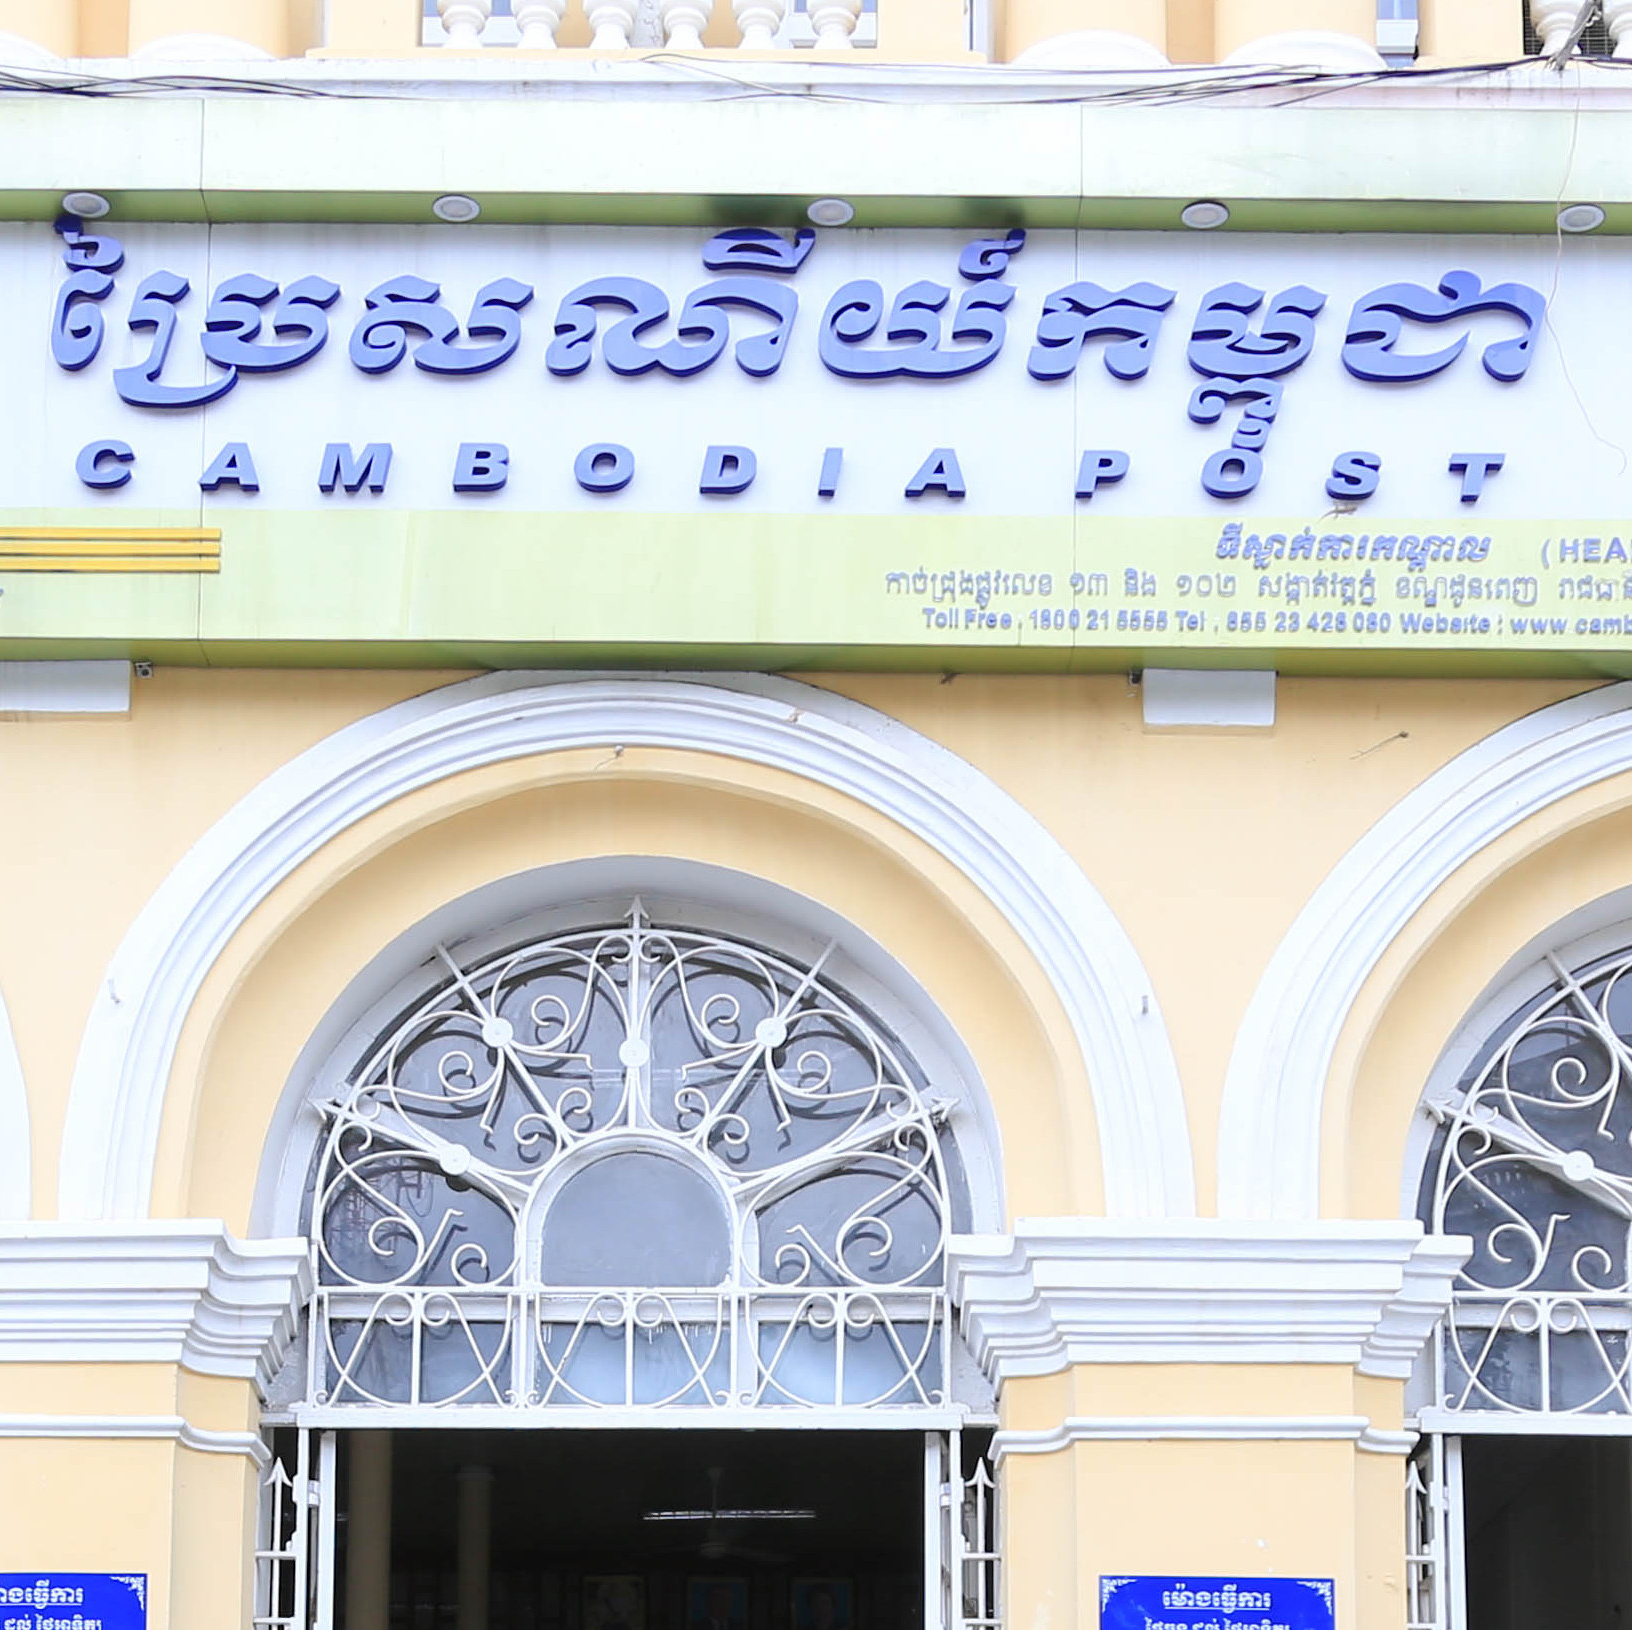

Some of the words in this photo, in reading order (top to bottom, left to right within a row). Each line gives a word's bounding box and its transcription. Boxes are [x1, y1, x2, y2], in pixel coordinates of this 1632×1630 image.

[75, 439, 967, 500] CAMBODIA
[1075, 449, 1506, 503] POST
[923, 607, 959, 629] Toll
[964, 608, 1012, 630] Free
[1086, 610, 1110, 632] 21
[1116, 610, 1169, 632] 5555
[1175, 610, 1206, 632] Tel
[1227, 611, 1267, 633] 855
[1274, 611, 1300, 633] 23
[1306, 612, 1348, 633] 428
